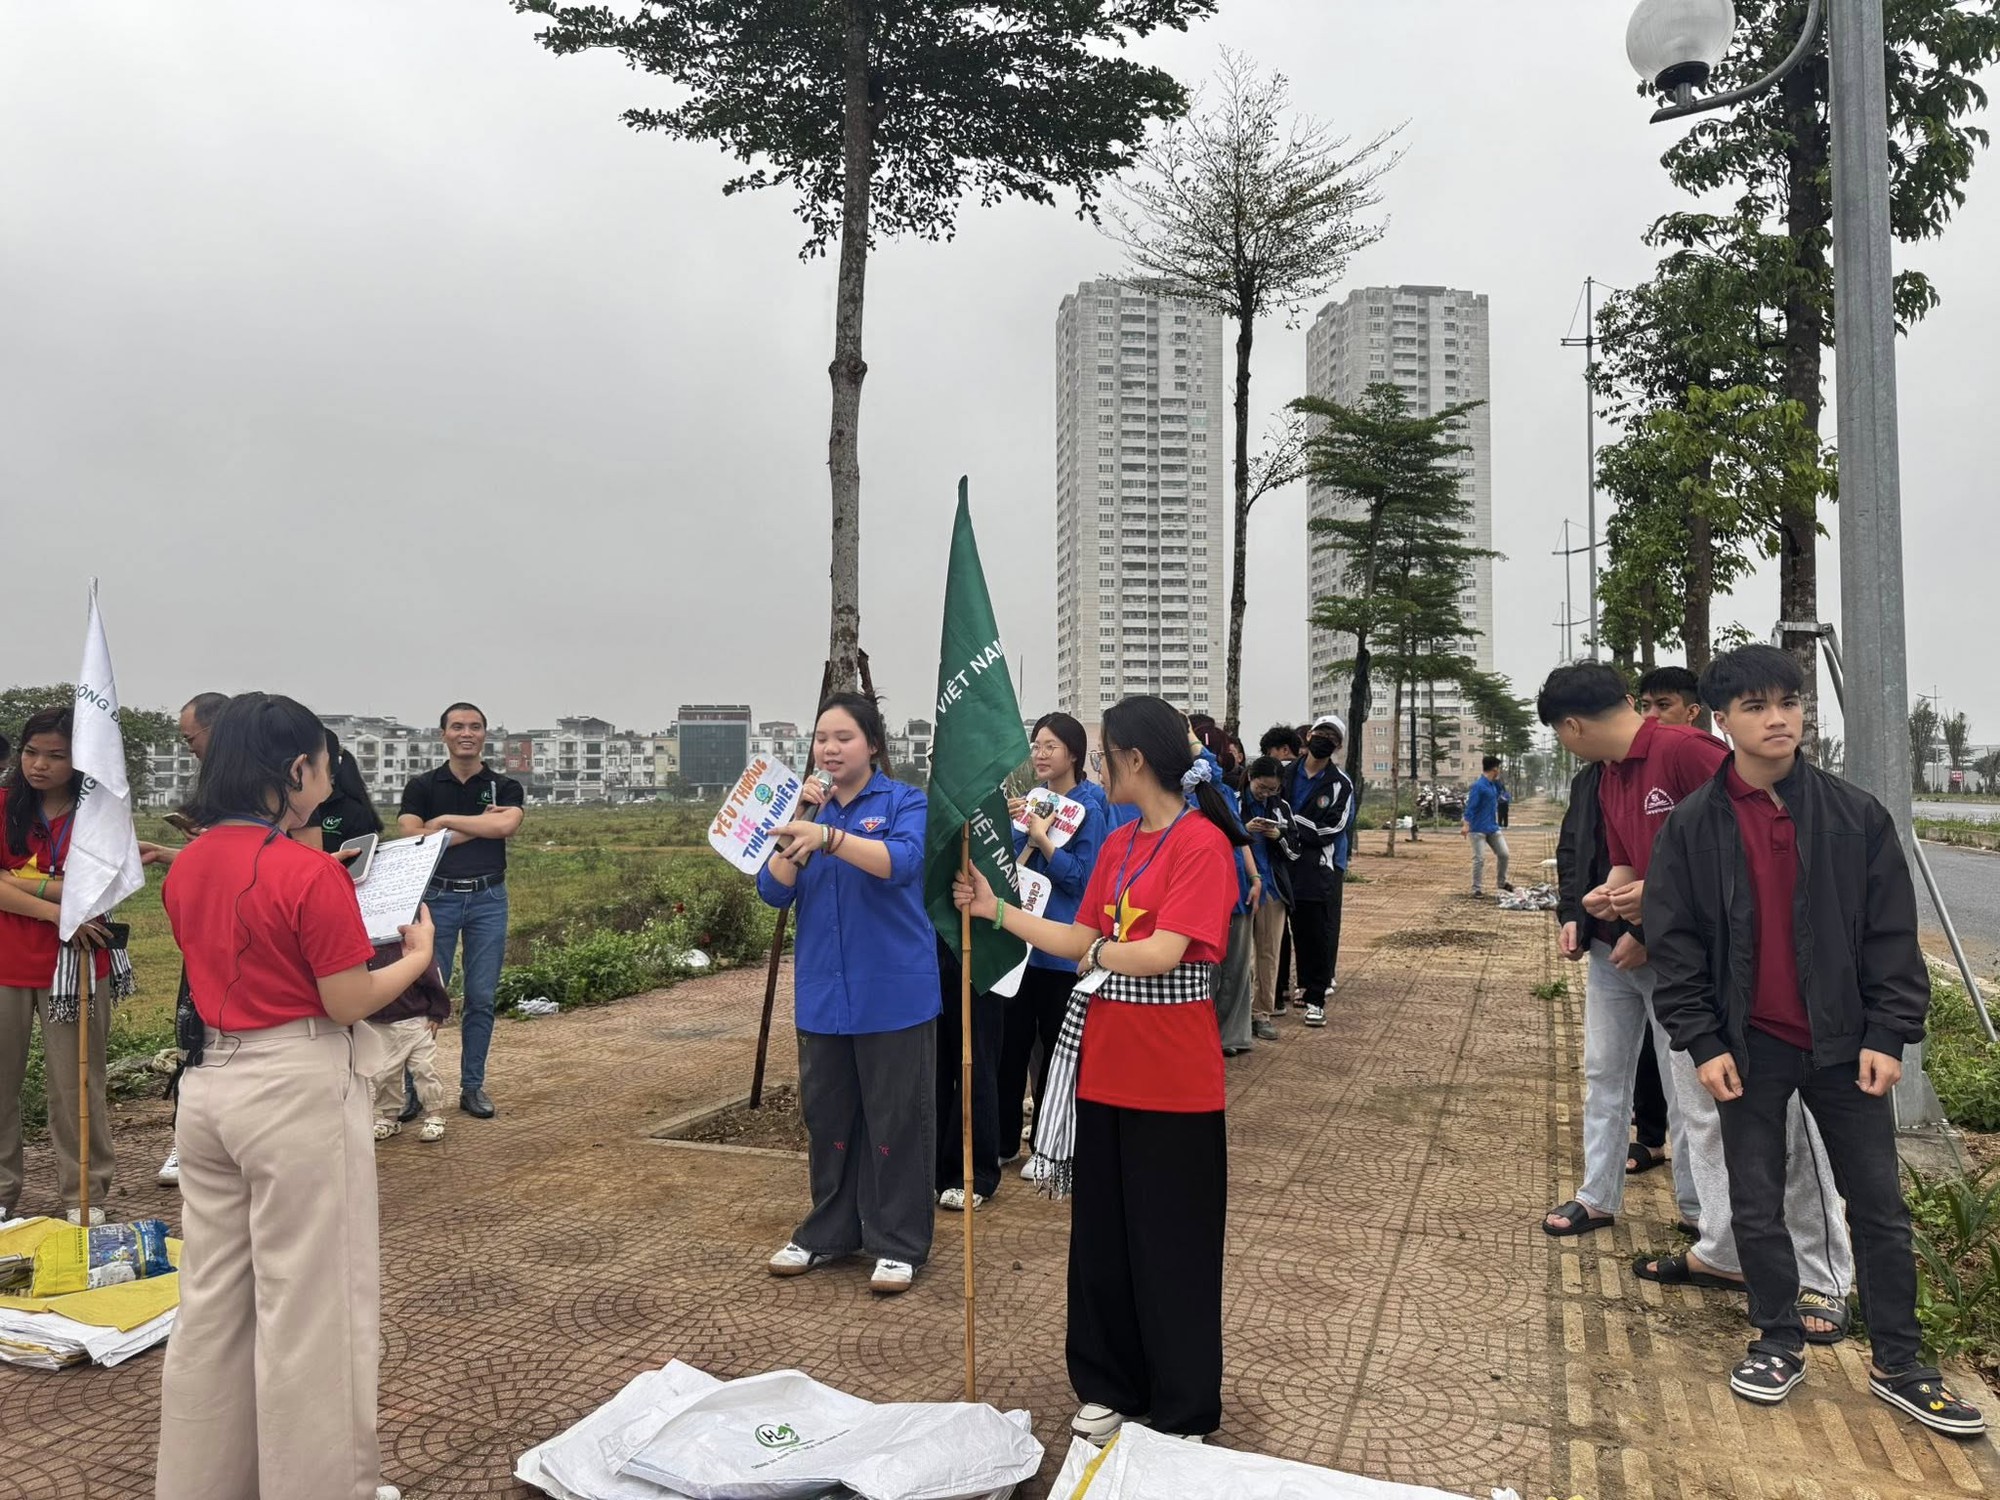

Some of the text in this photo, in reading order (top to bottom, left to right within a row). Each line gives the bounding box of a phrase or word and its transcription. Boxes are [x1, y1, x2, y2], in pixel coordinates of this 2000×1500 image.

[937, 669, 970, 714] VIỆT
[712, 804, 738, 838] YÊU
[742, 777, 799, 859] THIÊN NHIÊN
